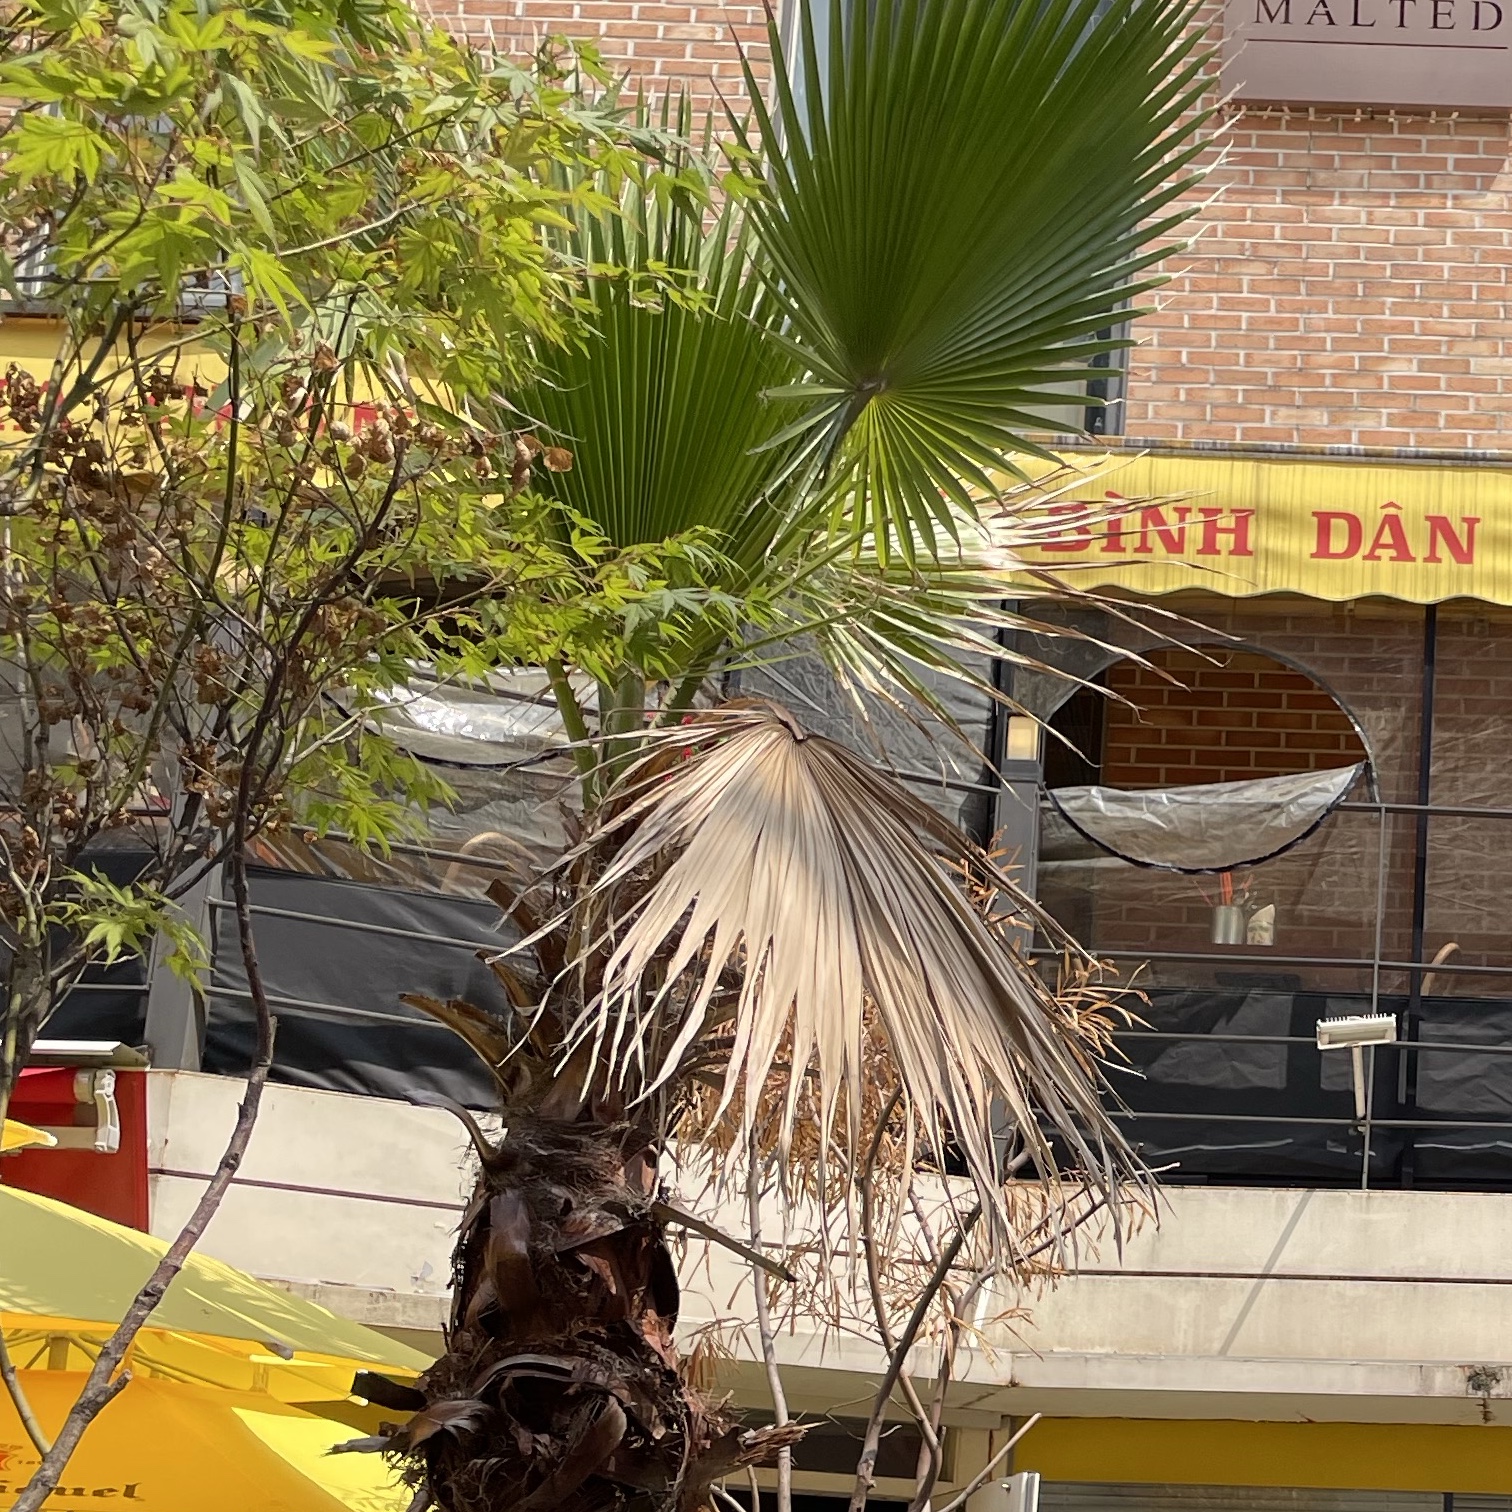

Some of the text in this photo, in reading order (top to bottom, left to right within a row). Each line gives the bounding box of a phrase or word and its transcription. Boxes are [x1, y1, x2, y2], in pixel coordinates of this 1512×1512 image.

[1252, 0, 1503, 31] MALTED
[1041, 490, 1256, 557] BÌNH
[1309, 501, 1481, 565] DÂN
[0, 1480, 146, 1501] iuel
